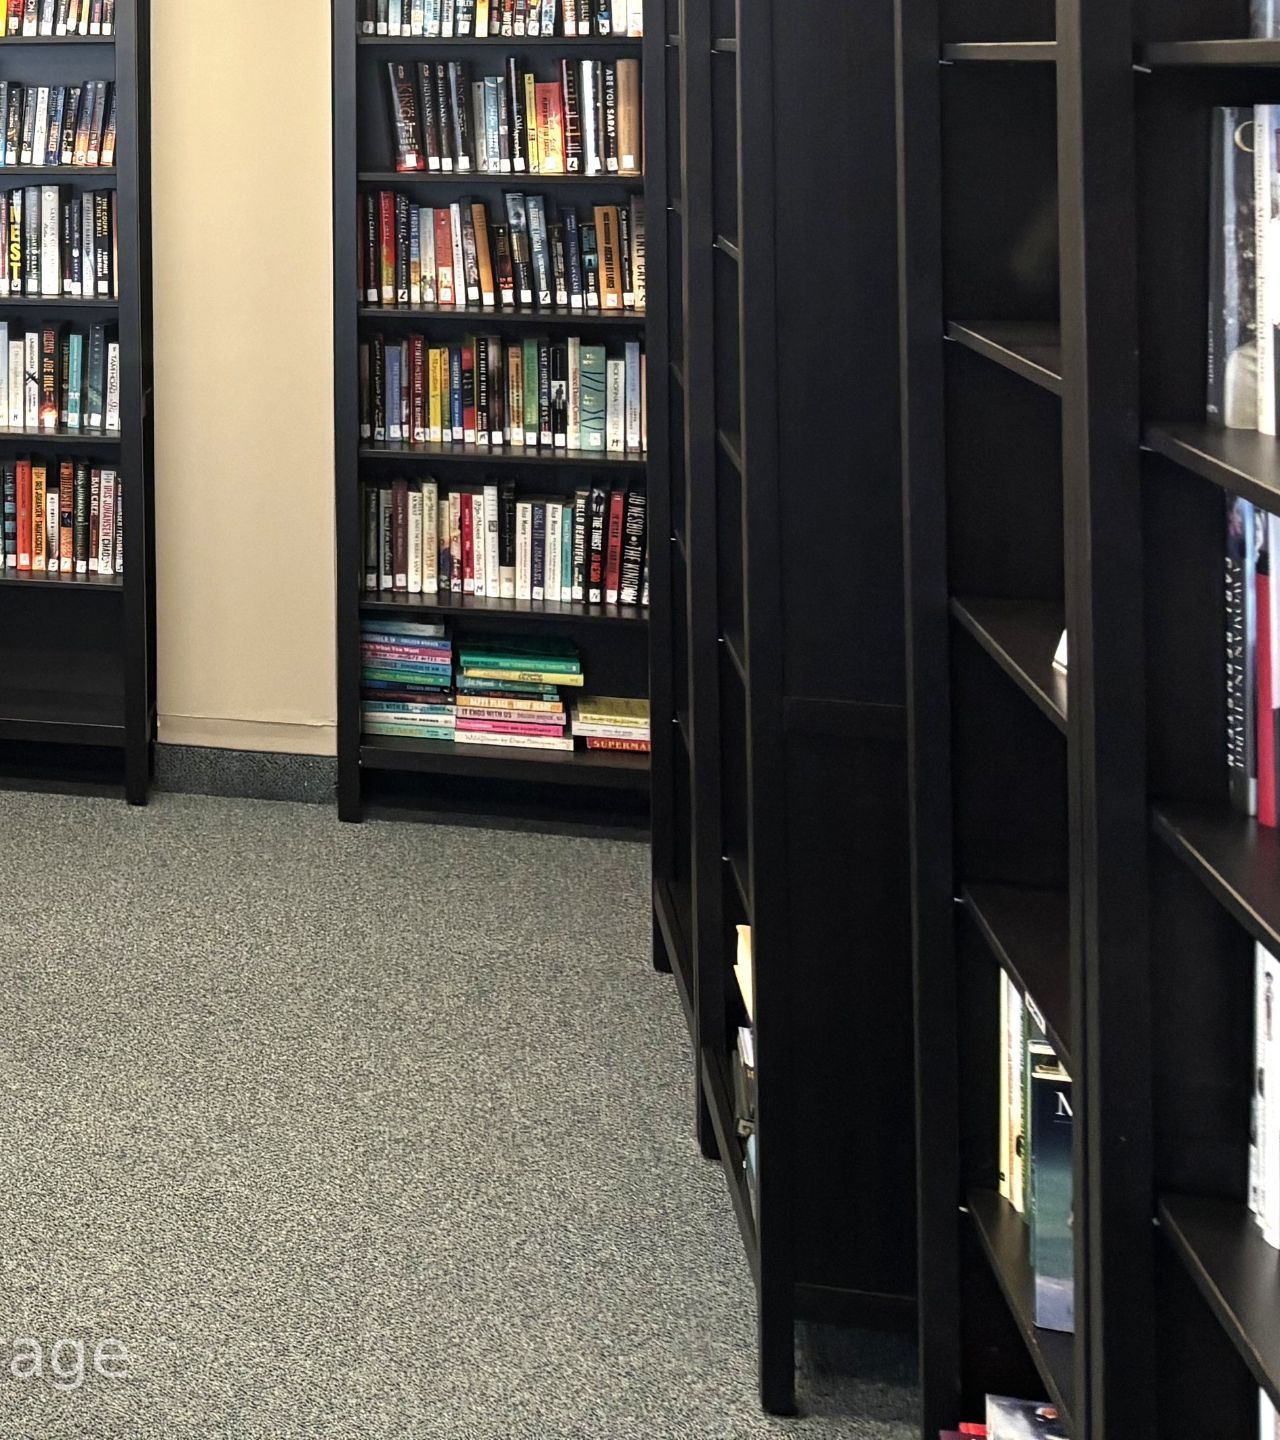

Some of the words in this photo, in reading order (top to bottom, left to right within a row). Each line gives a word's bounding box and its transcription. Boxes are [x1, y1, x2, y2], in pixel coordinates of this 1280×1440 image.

[397, 83, 414, 117] KING
[606, 88, 614, 107] YOU
[607, 108, 616, 138] SARA?
[1256, 122, 1266, 200] Passionate
[400, 198, 409, 223] HARPER
[31, 235, 40, 255] DAVID
[636, 233, 646, 260] ONLY
[31, 256, 39, 278] GRANN
[1256, 275, 1267, 339] Powerful
[540, 347, 549, 366] LAST
[43, 374, 54, 393] HILL
[541, 368, 550, 392] HOUSE
[612, 377, 621, 403] MOFINA
[541, 395, 550, 423] GUEST
[62, 471, 73, 508] JOHANSEN
[91, 476, 99, 495] BAD
[35, 492, 44, 518] JOHANSEN
[76, 486, 86, 521] JOHANSEN
[90, 495, 98, 516] CREE
[575, 498, 586, 523] HELLO
[102, 500, 112, 537] JOHANSEN
[574, 524, 585, 566] BEAUTIFUL
[591, 529, 602, 551] THIRST
[623, 544, 642, 562] THE
[620, 562, 639, 604] KINGDOM
[1224, 556, 1233, 614] CARL
[1233, 581, 1244, 659] WOMAN
[1234, 664, 1244, 688] IN
[1226, 631, 1235, 767] BERNSTEIN
[1234, 692, 1245, 768] CHARGE
